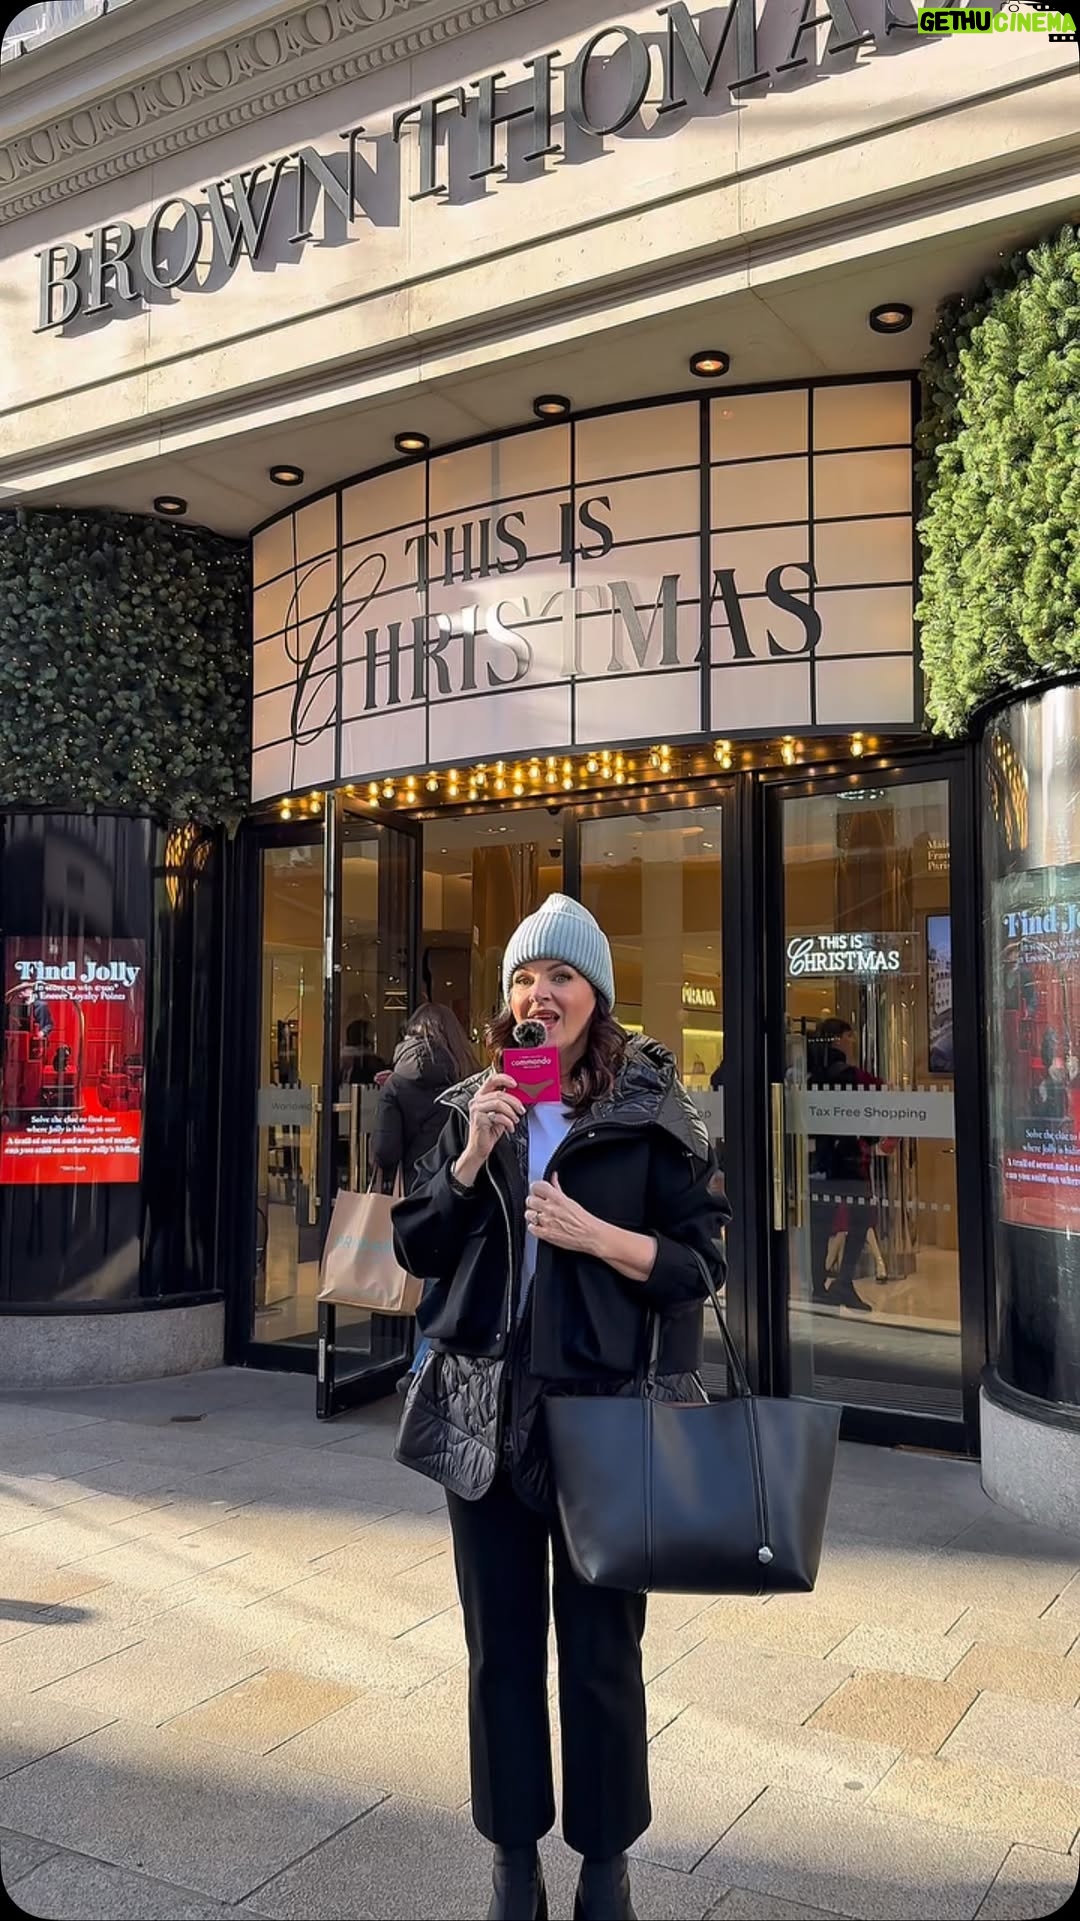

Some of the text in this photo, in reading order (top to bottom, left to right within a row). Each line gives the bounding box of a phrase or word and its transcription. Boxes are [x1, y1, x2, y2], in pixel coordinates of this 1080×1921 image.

[33, 126, 365, 334] BROWN
[404, 496, 613, 592] THIS IS
[284, 561, 822, 746] CHRISTMAS
[1002, 905, 1057, 938] Find
[787, 938, 900, 976] CHRISTMAS
[818, 935, 863, 949] THIS IS
[14, 961, 141, 987] Find Jolly
[511, 1055, 552, 1067] commando
[809, 1106, 927, 1121] Tax Free Shopping
